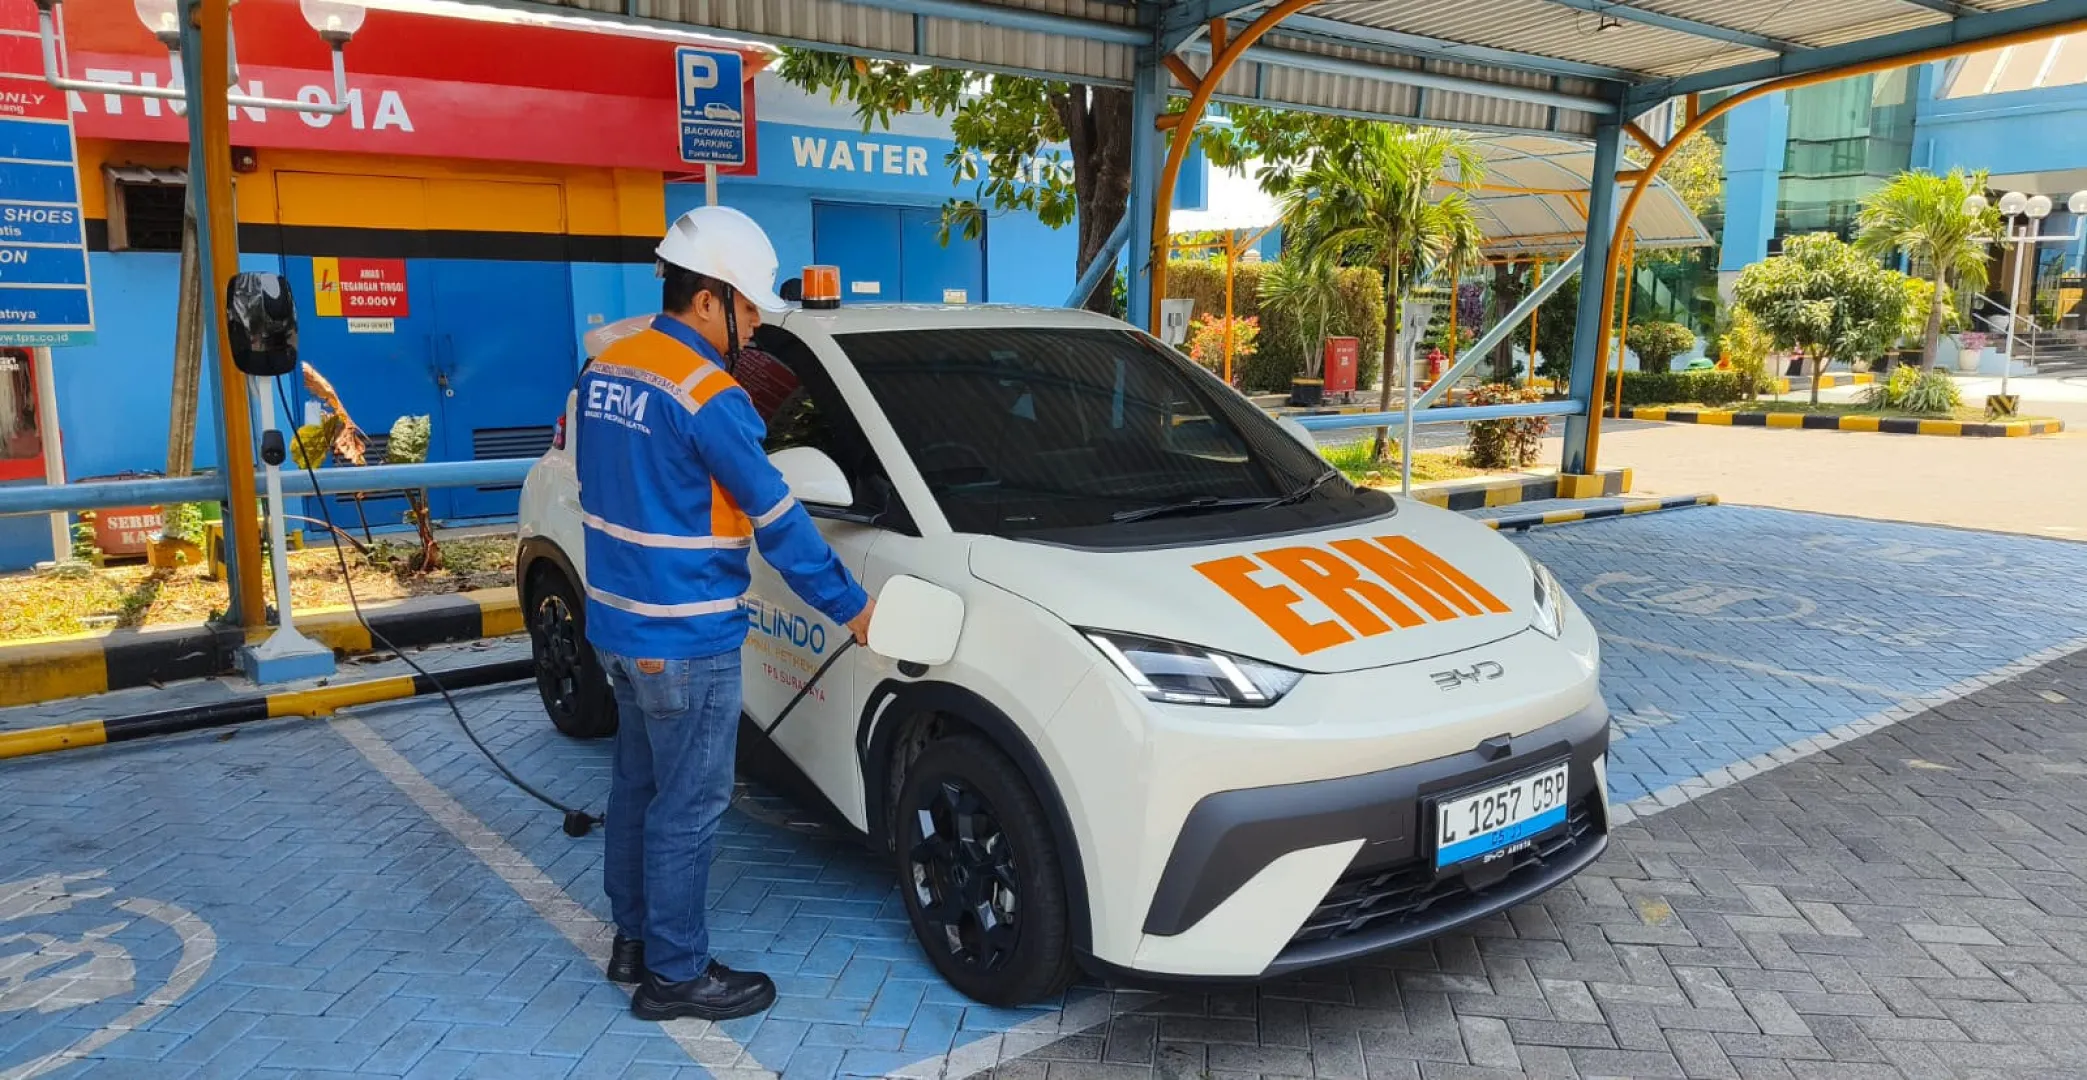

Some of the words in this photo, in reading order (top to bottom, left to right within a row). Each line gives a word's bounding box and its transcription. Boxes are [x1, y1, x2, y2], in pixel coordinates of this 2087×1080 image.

[684, 125, 741, 139] BACKWARDS
[693, 138, 733, 150] PARKING
[792, 136, 928, 176] WATER
[4, 208, 73, 224] SHOES
[588, 380, 649, 422] ERM
[1190, 534, 1513, 656] ERM
[1430, 660, 1505, 691] BYD
[1442, 809, 1456, 844] L
[1469, 786, 1523, 836] 1257
[1532, 771, 1565, 812] CBP
